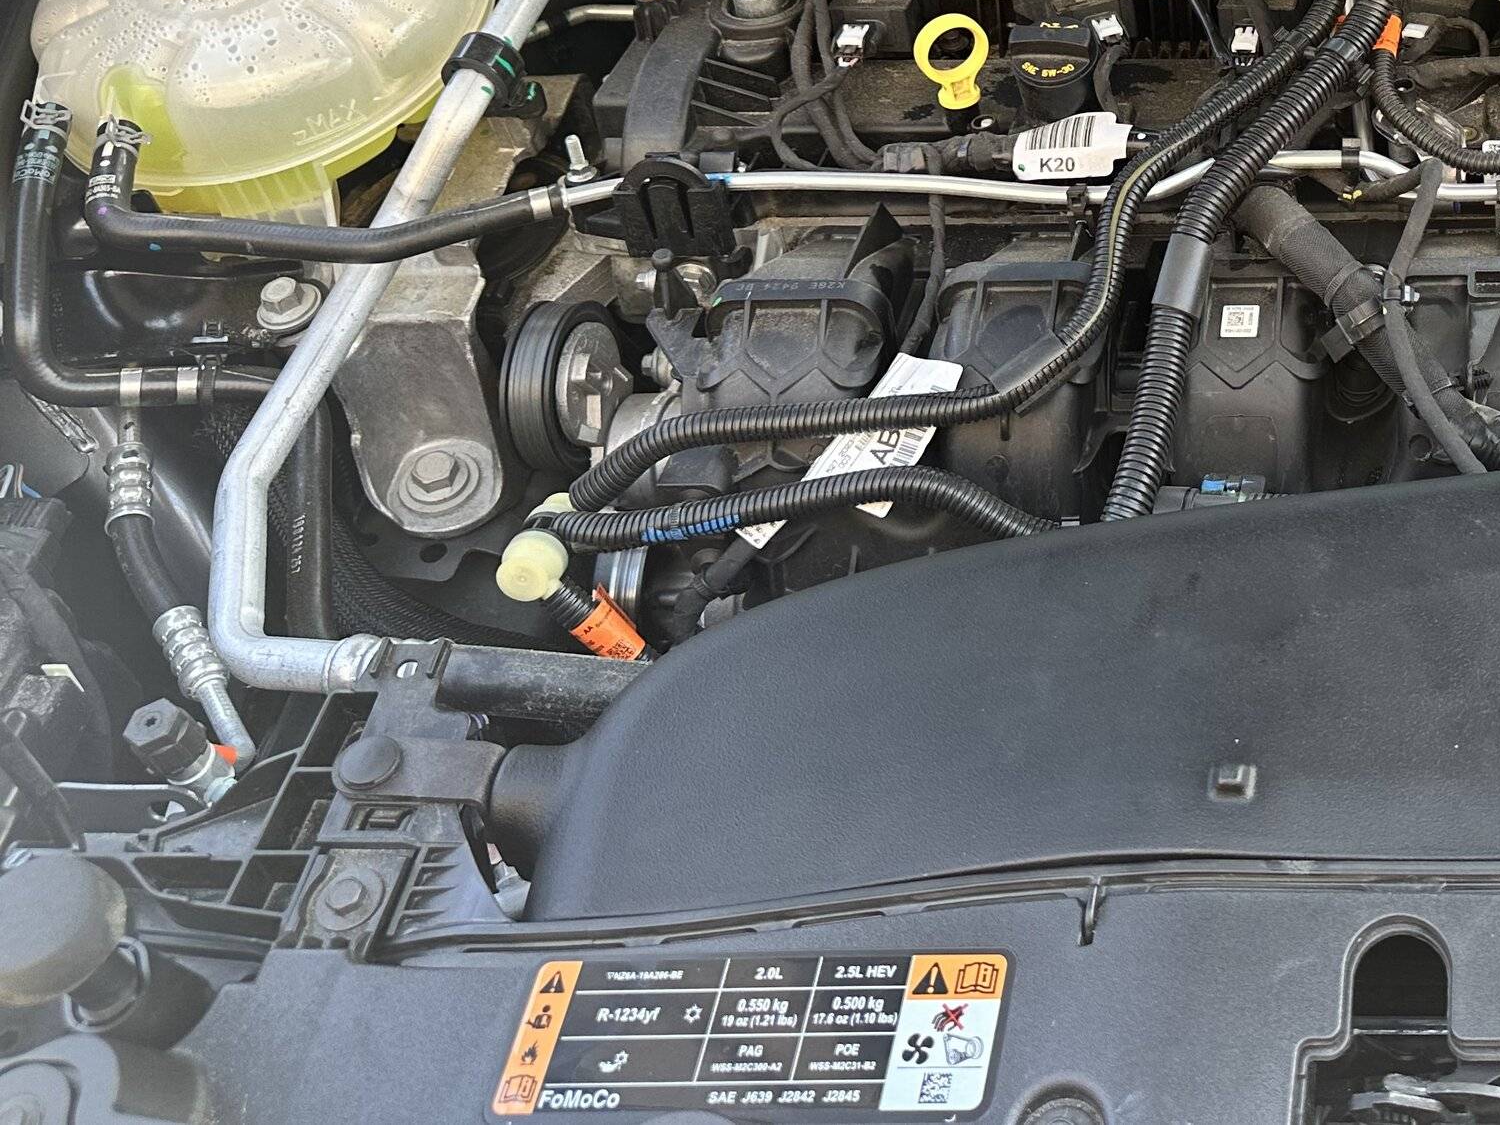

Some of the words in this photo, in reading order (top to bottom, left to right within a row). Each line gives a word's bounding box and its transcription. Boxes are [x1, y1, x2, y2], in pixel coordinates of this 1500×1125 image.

[1021, 61, 1040, 75] SAE
[1041, 63, 1075, 77] 5W-30
[1039, 156, 1076, 173] K20
[754, 966, 784, 980] 2.0L
[834, 966, 864, 979] 2.5L
[865, 965, 898, 979] HEV
[736, 998, 772, 1013] 0.550
[772, 998, 789, 1014] kg
[832, 996, 866, 1011] 0.500
[867, 996, 885, 1013] kg
[596, 1006, 662, 1025] R-1234yf
[721, 1014, 735, 1027] 19
[736, 1016, 749, 1027] oz
[749, 1014, 776, 1029] (1.21
[777, 1013, 798, 1028] lbs)
[812, 1012, 834, 1025] 17.6
[835, 1014, 849, 1025] oz
[877, 1011, 899, 1026] lbs)
[738, 1044, 764, 1058] PAG
[834, 1043, 861, 1056] POE
[538, 1088, 620, 1109] FoMoCo
[707, 1090, 738, 1105] SAE
[742, 1090, 773, 1104] J639
[777, 1089, 816, 1104] J2842
[822, 1089, 861, 1104] J2845
